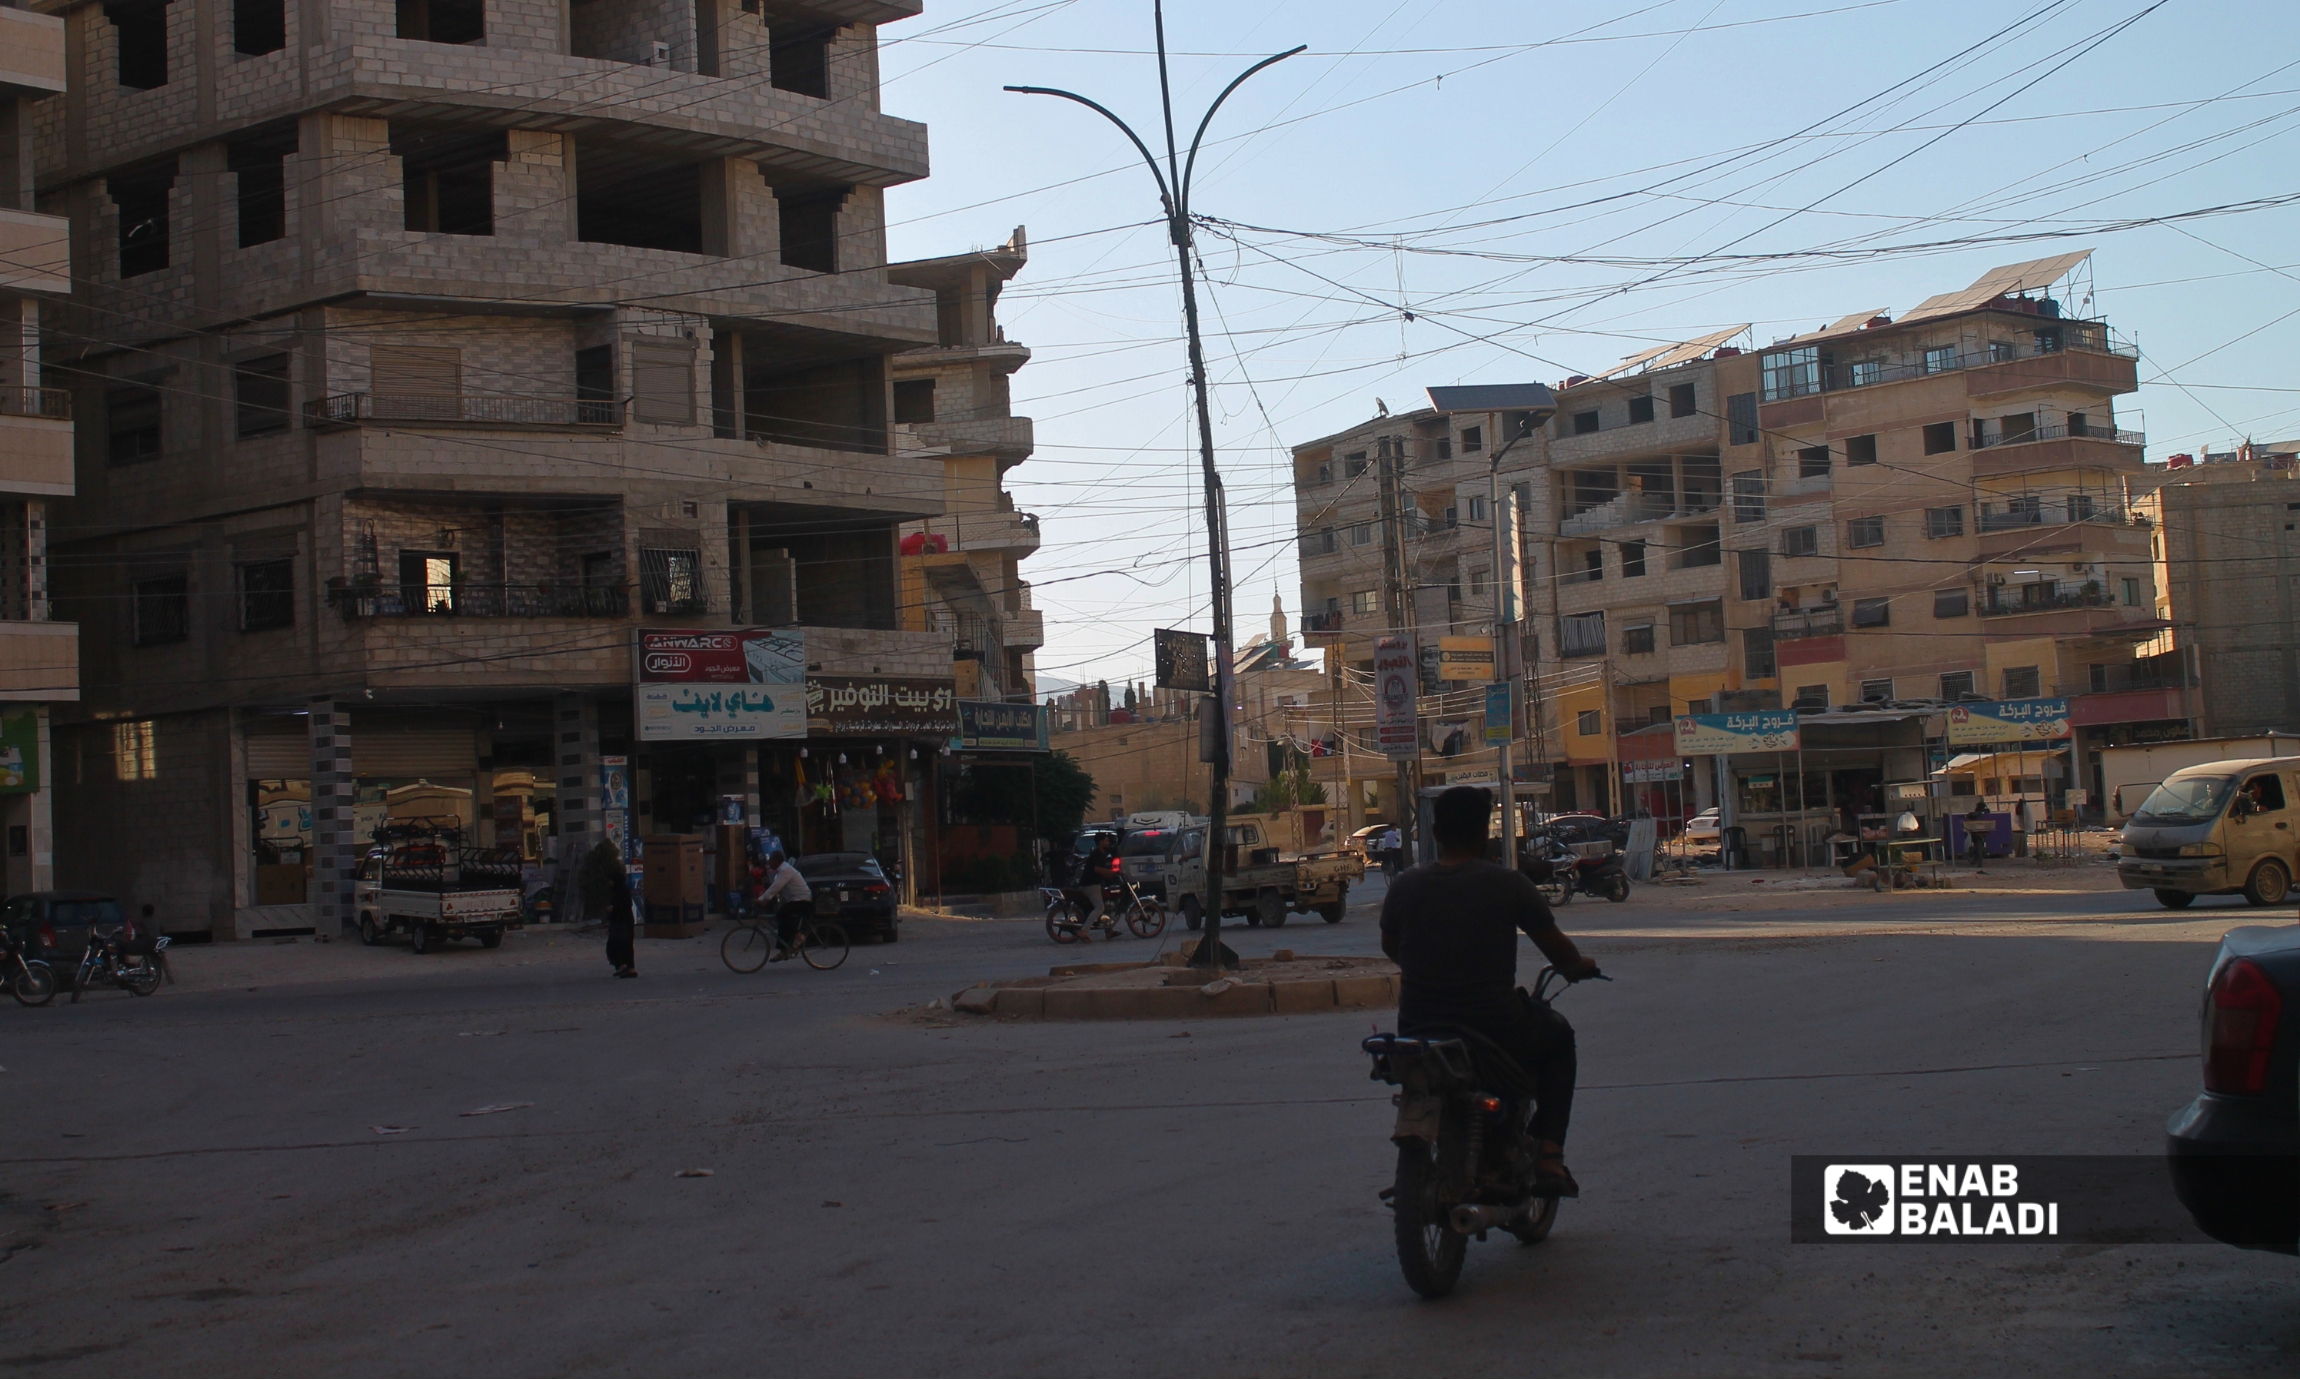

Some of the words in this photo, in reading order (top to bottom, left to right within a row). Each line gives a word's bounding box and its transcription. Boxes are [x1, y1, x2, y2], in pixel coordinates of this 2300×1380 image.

[651, 656, 686, 669] الأنوار
[704, 665, 720, 673] الجود
[720, 665, 741, 673] معرض
[828, 682, 889, 712] التوفير
[895, 687, 929, 712] بيت
[1999, 703, 2031, 719] البركة
[2034, 701, 2067, 718] فروج
[694, 725, 721, 733] الجود
[723, 725, 755, 734] معرض
[1726, 715, 1758, 731] البركة
[1762, 714, 1794, 730] فروج
